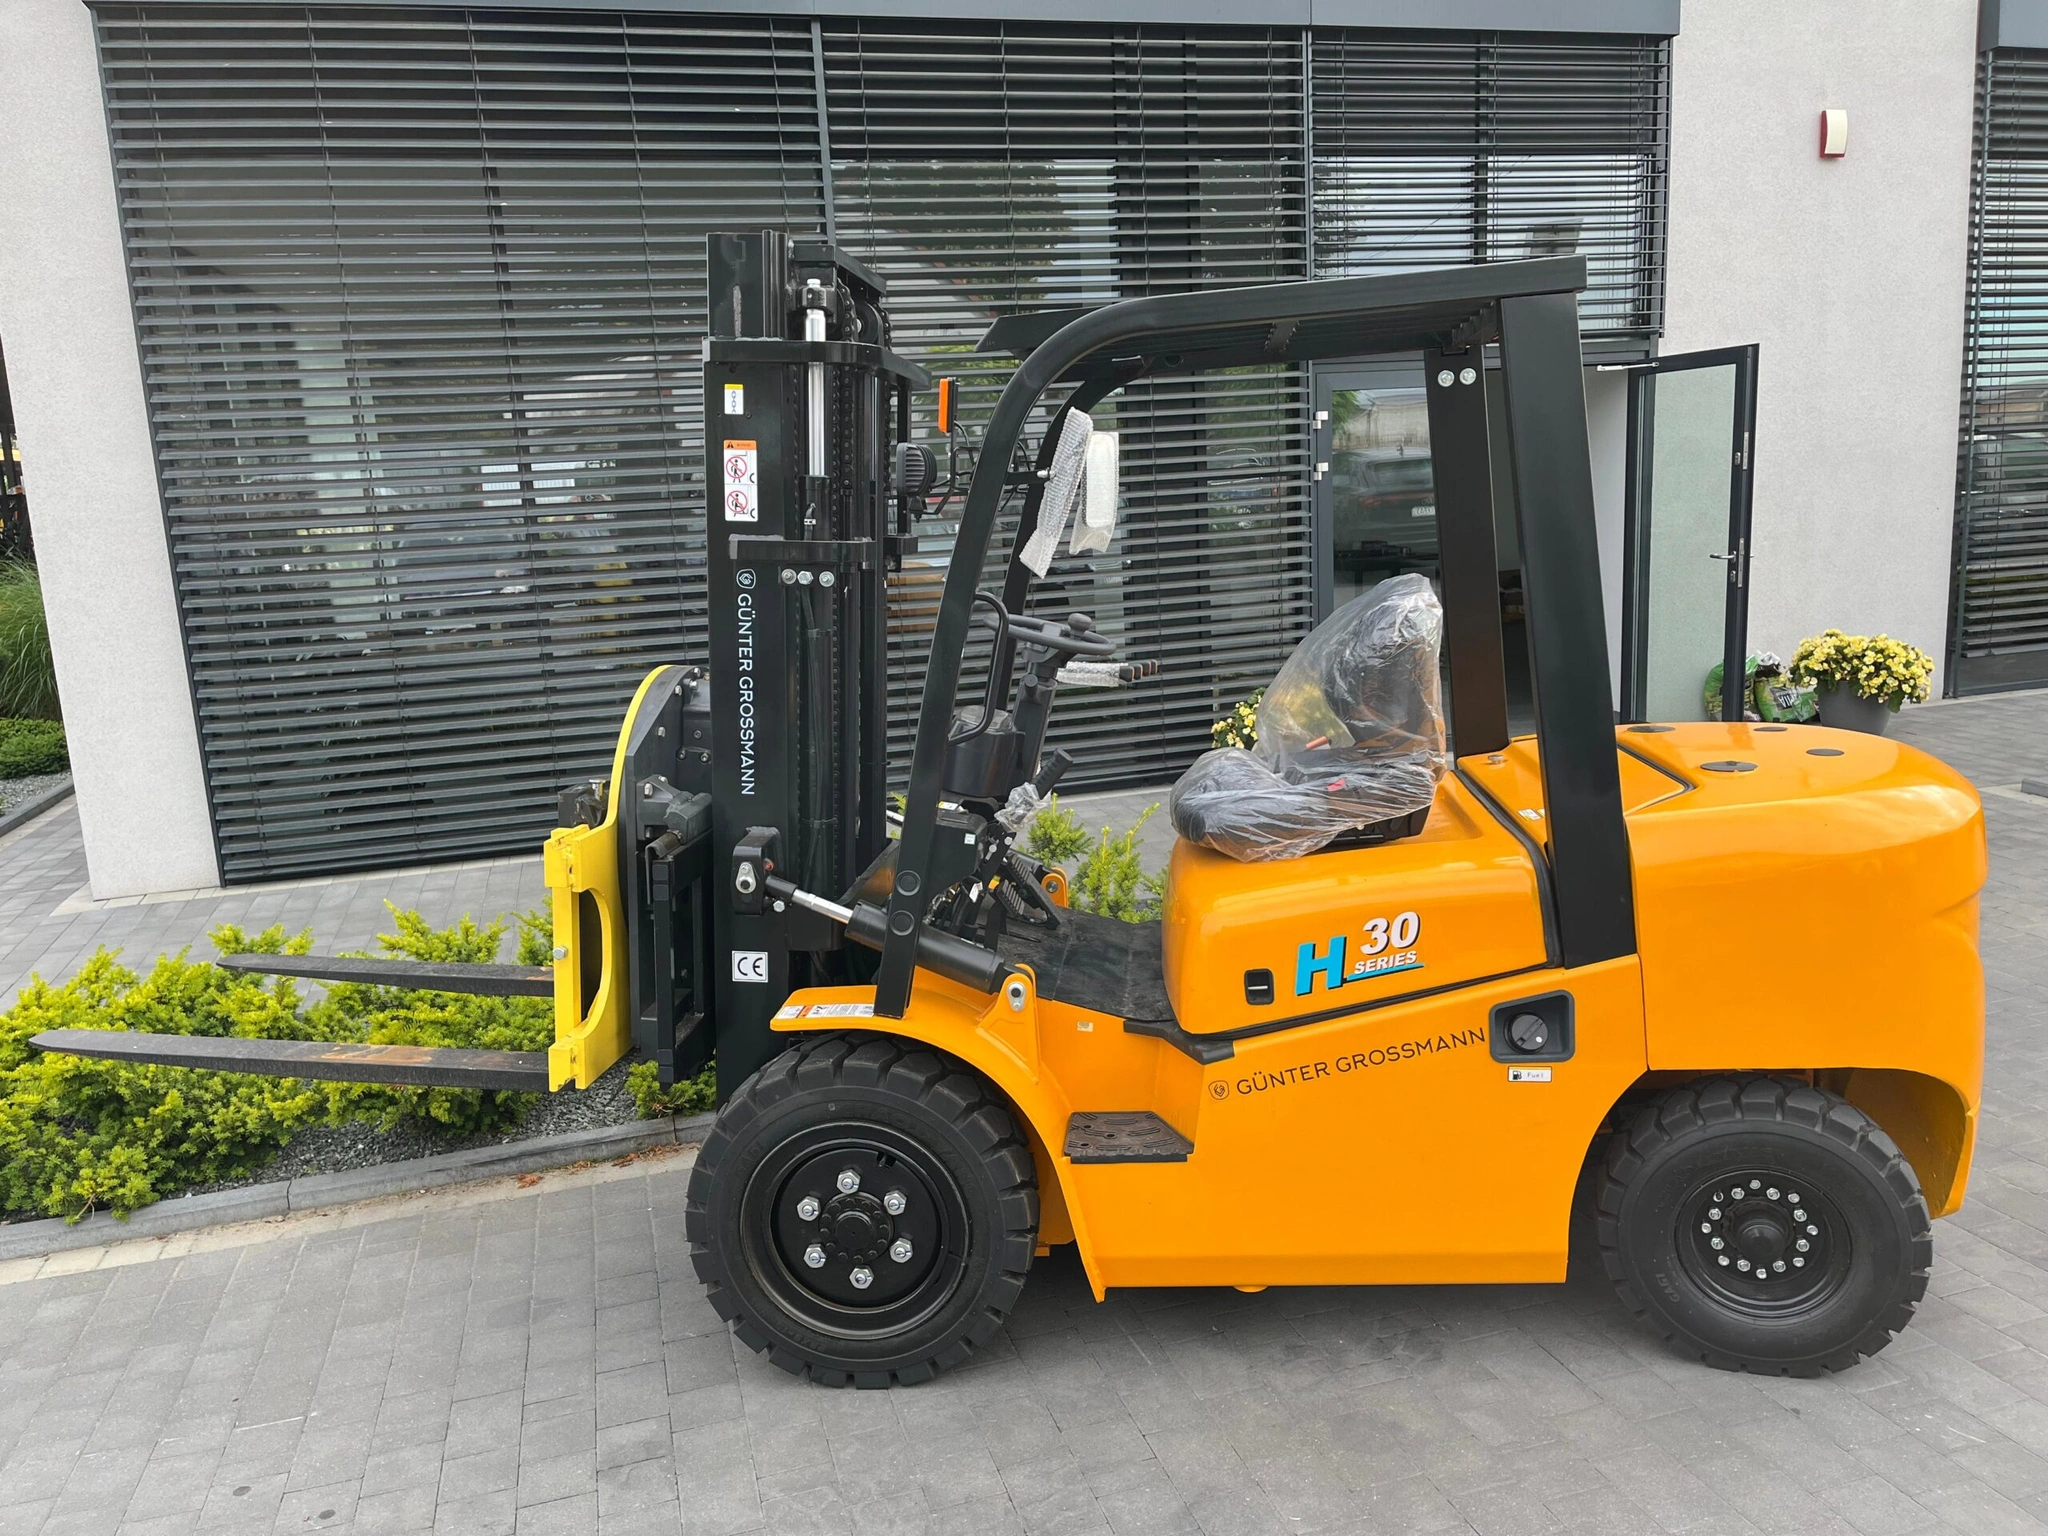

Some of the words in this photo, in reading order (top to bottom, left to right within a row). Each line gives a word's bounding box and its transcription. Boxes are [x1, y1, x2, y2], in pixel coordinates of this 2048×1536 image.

[738, 593, 756, 671] GÜNTER
[739, 677, 755, 795] GROSSMANN
[1354, 950, 1417, 975] SERIES
[1360, 911, 1421, 956] 30
[737, 956, 763, 977] CE
[1295, 935, 1347, 997] H
[1236, 1061, 1330, 1095] GÜNTER
[1336, 1027, 1486, 1073] GROSSMANN
